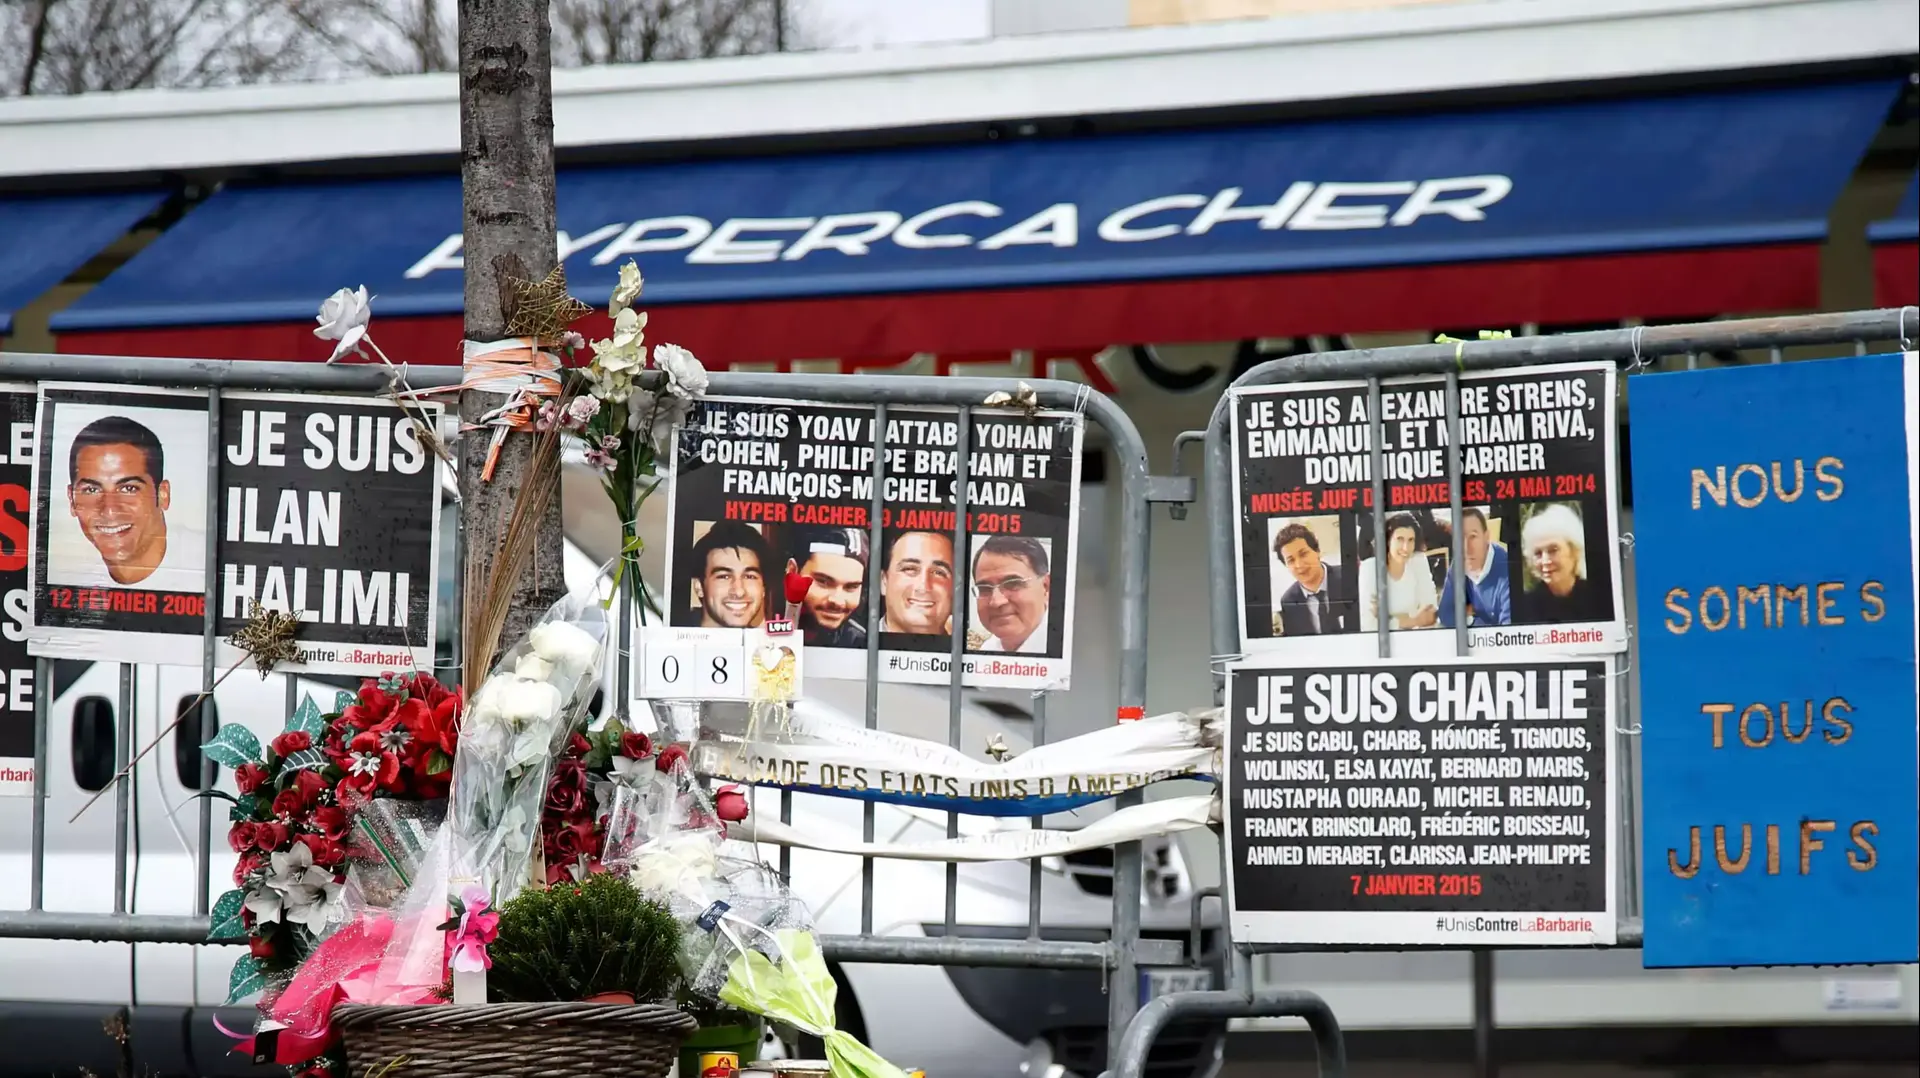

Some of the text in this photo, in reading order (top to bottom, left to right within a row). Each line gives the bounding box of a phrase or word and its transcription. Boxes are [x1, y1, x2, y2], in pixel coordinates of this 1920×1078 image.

[1245, 378, 1596, 430] JE SUIS AEXANRE STRENS,
[226, 410, 425, 474] JE SUIS
[701, 410, 727, 435] JE
[734, 411, 789, 438] SUIS
[798, 415, 861, 441] YOAV
[976, 423, 1053, 449] YOHAN
[1400, 420, 1430, 449] ET
[1531, 409, 1595, 441] RIVA,
[701, 439, 788, 470] COHEN,
[1022, 455, 1050, 478] ET
[1460, 442, 1546, 475] ABRIER
[723, 469, 942, 504] FRANÇOIS-MCHEL
[1251, 487, 1314, 513] MUSÉE
[1318, 489, 1358, 510] JUIF
[1391, 480, 1491, 506] BRUXEES,
[1495, 478, 1516, 499] 24
[1519, 476, 1551, 497] MAI
[1556, 473, 1596, 495] 2014
[1691, 456, 1844, 509] NOUS
[226, 486, 341, 546] ILAN
[725, 501, 787, 522] HYPER
[793, 504, 872, 529] CACHER,
[882, 508, 891, 528] 9
[977, 513, 1021, 533] 2015
[49, 589, 72, 609] 12
[77, 585, 157, 613] FÉVRIER
[222, 563, 410, 627] HALIMI
[1664, 580, 1886, 634] SOMMES
[768, 622, 792, 632] LOVE
[1468, 628, 1604, 648] UnisContreLaBarbarie
[301, 649, 412, 666] ontreLaBarbarie
[662, 656, 728, 684] 0 8
[890, 656, 1048, 677] #UnisCoreLaBarbarie
[1246, 669, 1588, 725] JE SUIS CHARLIE
[1702, 698, 1853, 748] TOUS
[1242, 732, 1263, 752] JE
[1265, 731, 1304, 752] SUIS
[1307, 730, 1358, 755] CABU,
[1363, 730, 1426, 754] CHARB,
[1511, 727, 1592, 751] TIGNOUS,
[820, 763, 868, 791] DES
[970, 778, 1027, 801] UNIS
[1244, 756, 1590, 783] WOLINSKI, ELSA KAYAT, BERNARD MARIS,
[1243, 785, 1591, 811] MUSTAPHA OURAAD, MICHEL RENAUD,
[1245, 811, 1590, 840] FRANCK BRINSOLARO, FRÉDÉRIC BOISSEAU,
[1246, 844, 1591, 868] AHMED MERABET, CLARISSA JEAN-PHILIPPE
[1668, 817, 1879, 878] JUIFS
[1351, 875, 1482, 895] 7 JANVIER 2015
[1436, 916, 1592, 932] #UnisContreLaBarbarie
